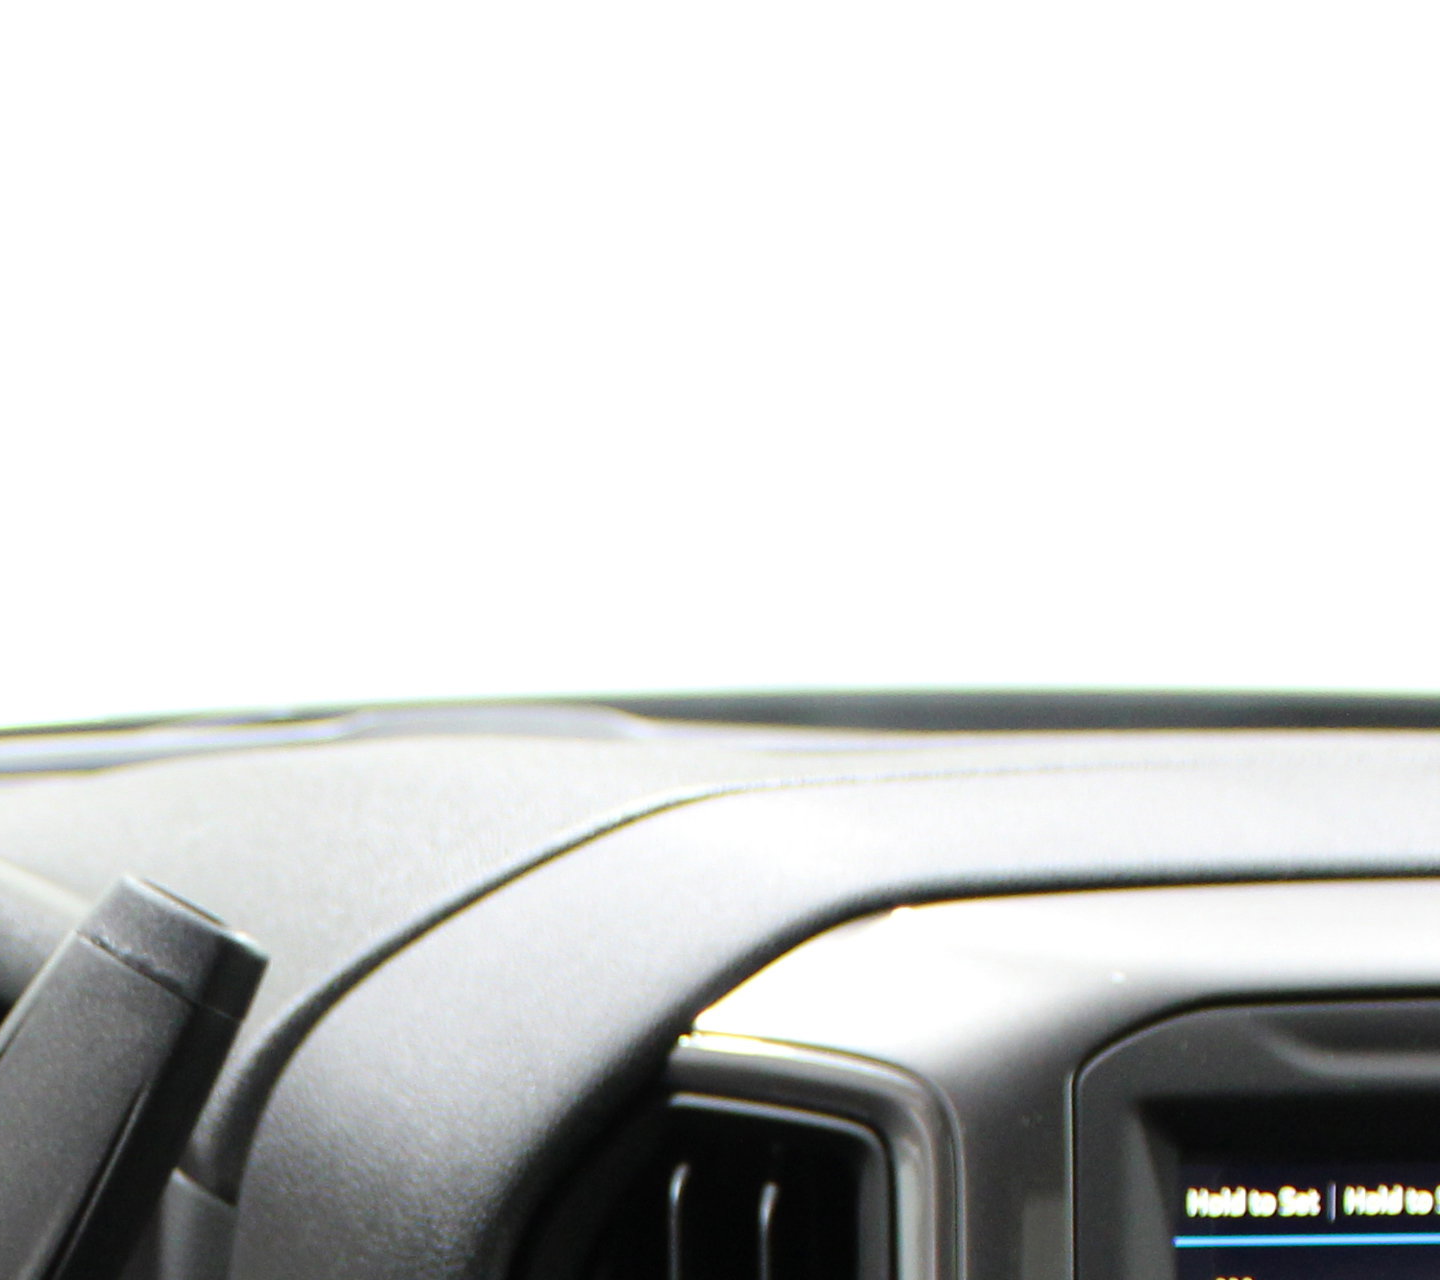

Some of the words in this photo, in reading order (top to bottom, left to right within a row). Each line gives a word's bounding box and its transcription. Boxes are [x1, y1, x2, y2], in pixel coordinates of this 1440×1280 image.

[1186, 1187, 1246, 1218] Hold
[1248, 1189, 1276, 1217] to
[1278, 1185, 1321, 1217] Set
[1344, 1185, 1403, 1216] Hold
[1405, 1187, 1433, 1215] to
